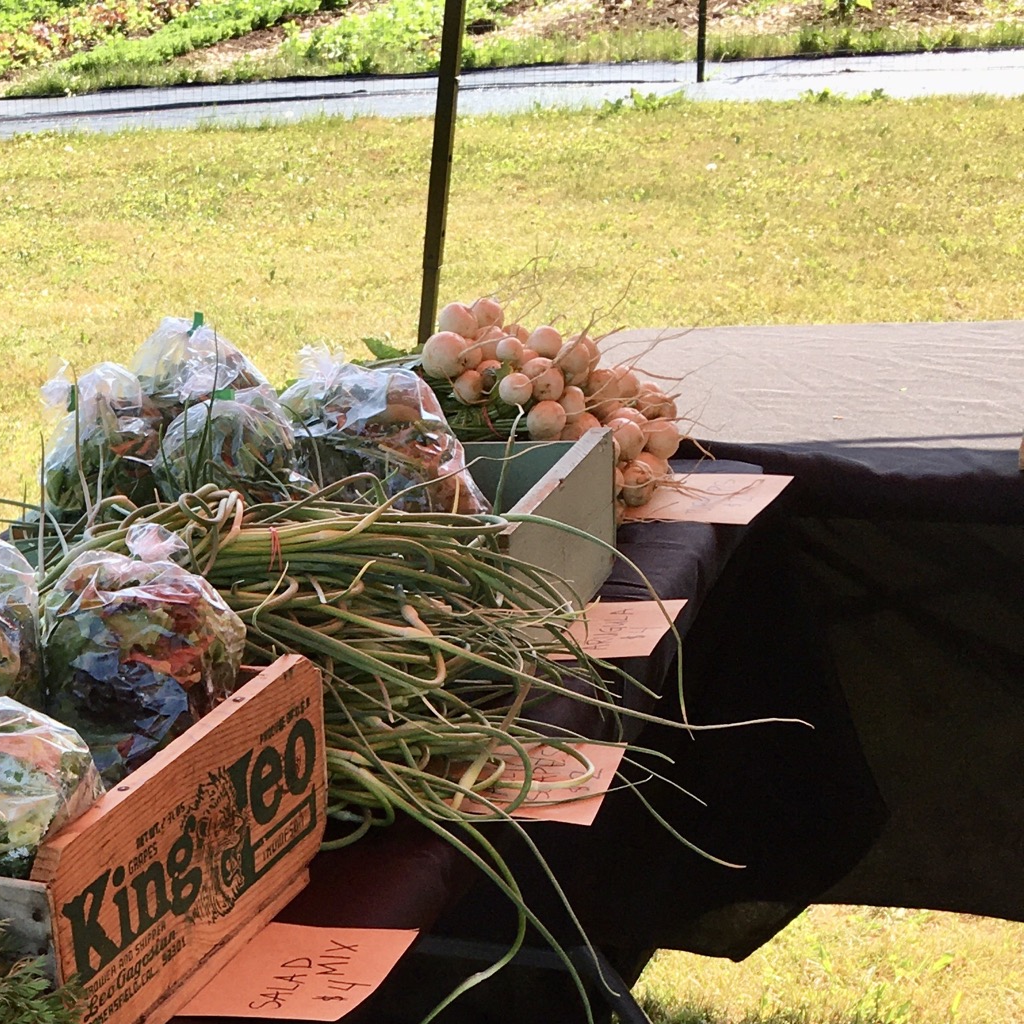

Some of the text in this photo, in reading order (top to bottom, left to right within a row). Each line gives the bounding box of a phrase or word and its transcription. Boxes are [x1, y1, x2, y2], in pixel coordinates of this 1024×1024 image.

[128, 841, 158, 875] GRAPES
[62, 814, 203, 986] King
[118, 949, 134, 970] AND
[135, 920, 167, 956] SHIPPER
[248, 940, 359, 1010] SALAD MIX
[83, 929, 176, 1022] Leo Gagosian
[312, 979, 372, 1002] $4
